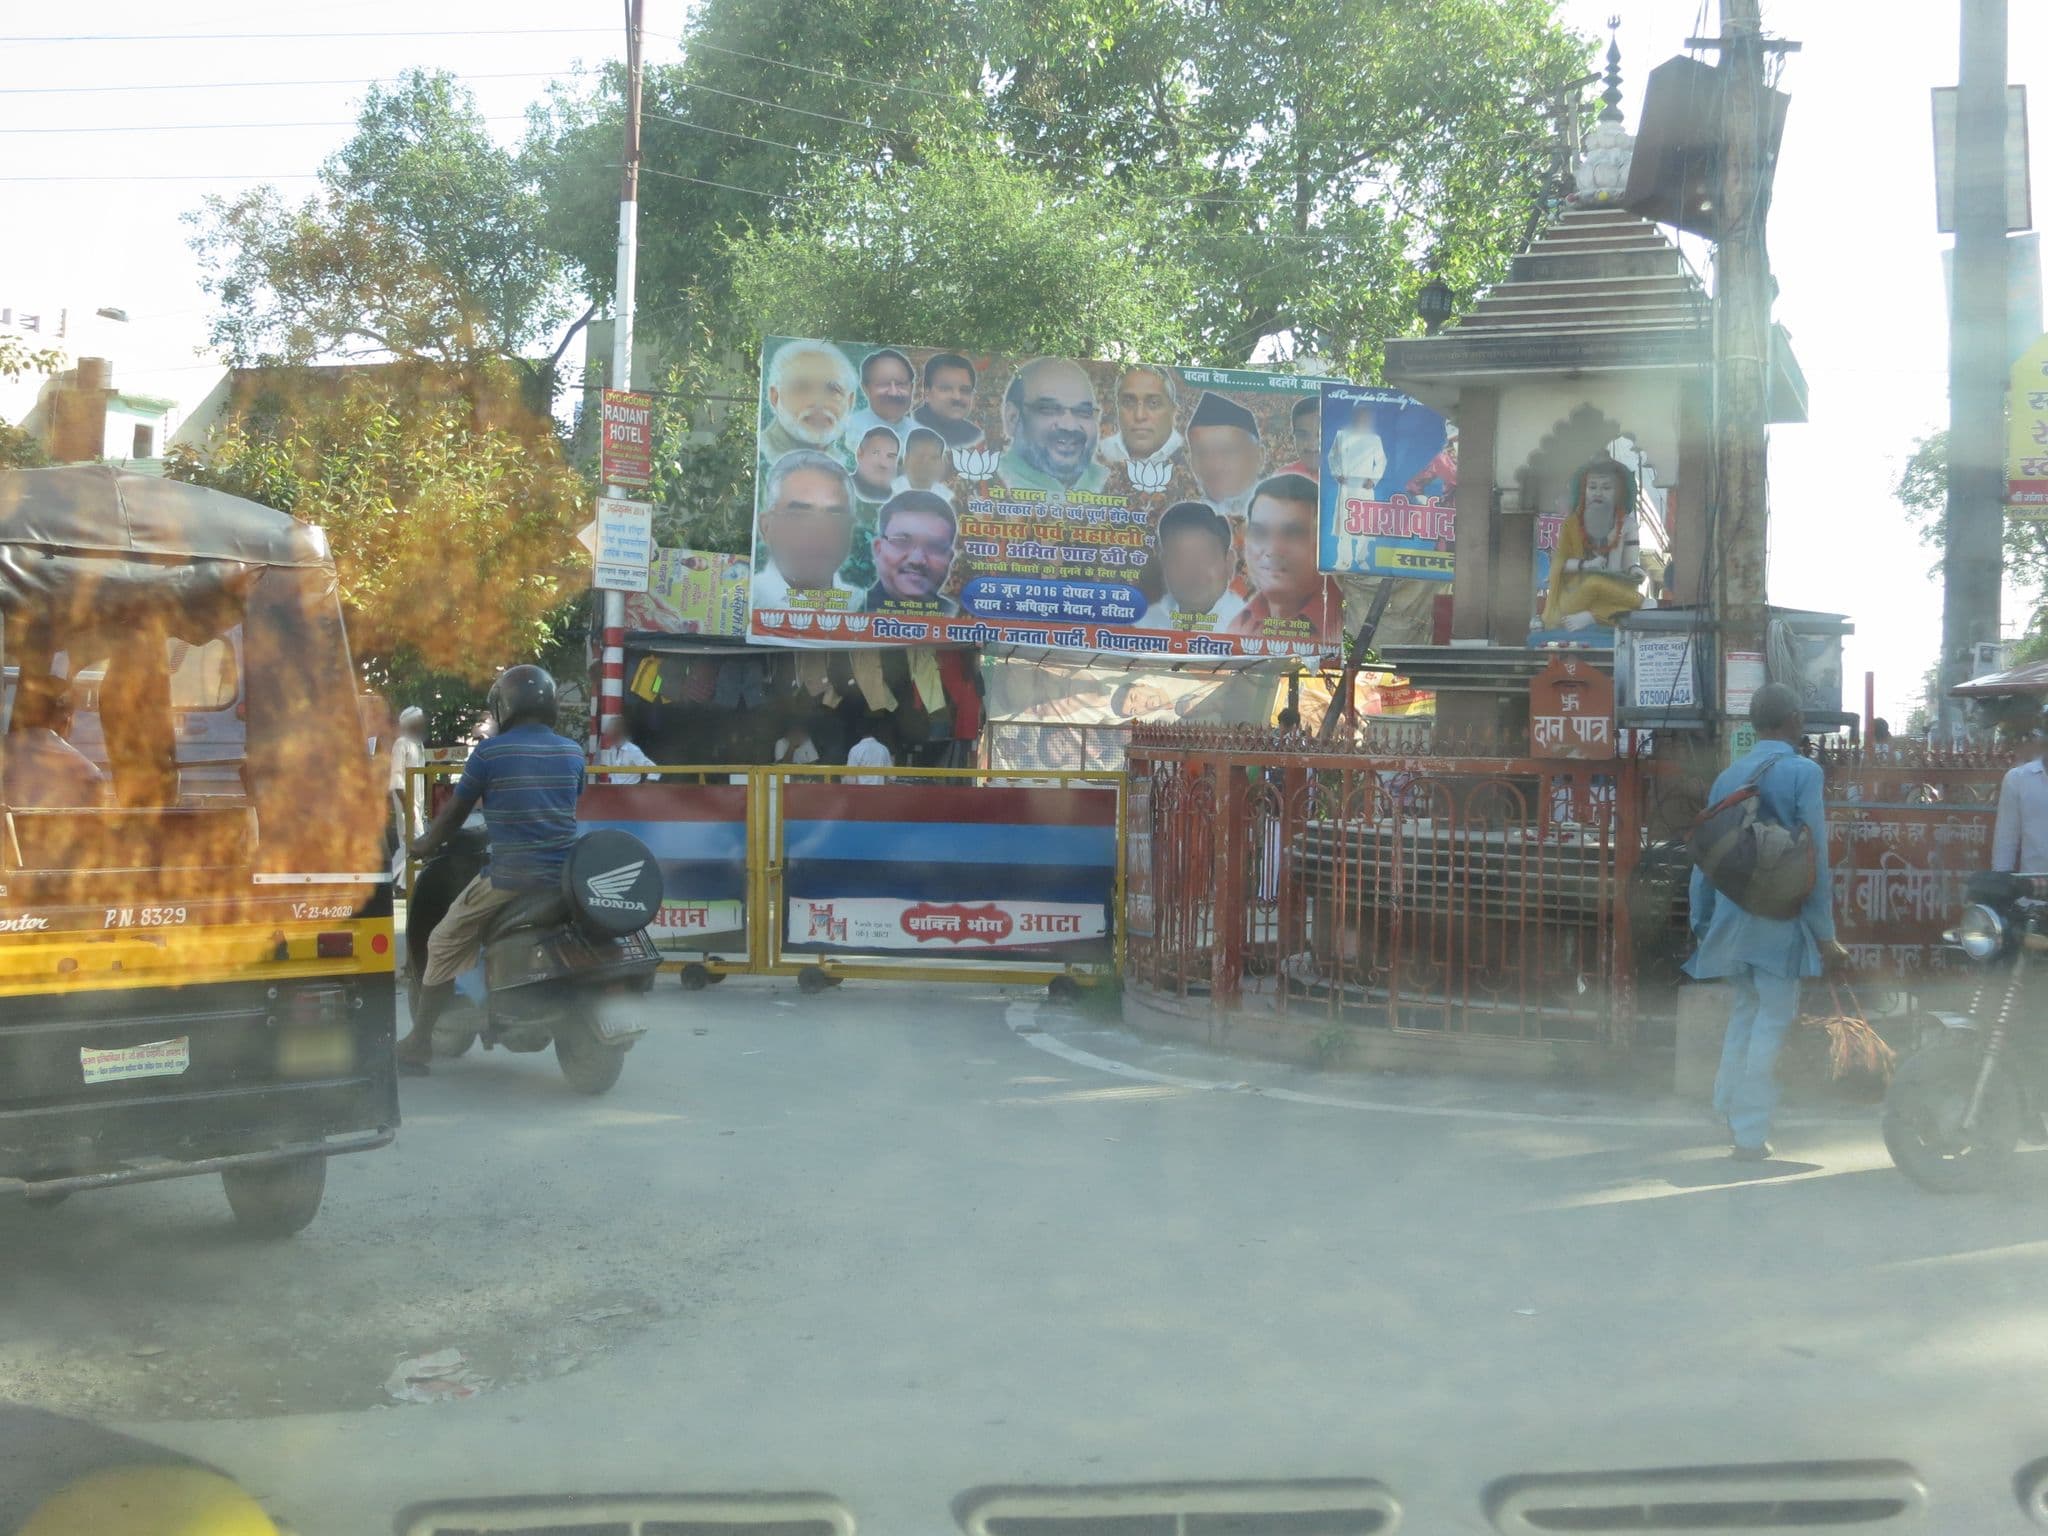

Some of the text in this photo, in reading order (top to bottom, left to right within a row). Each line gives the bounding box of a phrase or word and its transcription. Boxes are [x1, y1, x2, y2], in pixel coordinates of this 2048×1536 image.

[623, 394, 649, 408] ROOMS
[605, 404, 649, 426] RADIANT
[609, 423, 644, 444] HOTEL
[988, 485, 1006, 499] दो
[1010, 487, 1047, 502] साल
[968, 499, 1147, 525] मोदी सरकार के दो वर्ष पूर्ण होने पर
[1344, 493, 1457, 541] आशीर्वाद
[960, 514, 1029, 539] विकास
[1032, 520, 1064, 541] पर्व
[1006, 541, 1059, 560] अमित
[1061, 546, 1098, 563] शाह
[1100, 546, 1128, 565] जी
[1129, 550, 1149, 566] के
[980, 582, 997, 594] 25
[1001, 583, 1021, 597] जून
[1026, 585, 1058, 597] 2016
[1062, 584, 1095, 599] दोपहर
[1099, 589, 1107, 600] 3
[974, 599, 1001, 611] स्थान
[1016, 599, 1058, 617] ऋषिकुल
[1101, 603, 1136, 619] हरिद्वार
[872, 617, 928, 639] निवेदक
[946, 621, 1001, 643] भारतीय
[1005, 629, 1050, 645] जनता
[1096, 627, 1170, 652] विधानसभा
[1187, 635, 1233, 656] हरिद्वार
[1640, 689, 1691, 704] 875000424
[1534, 716, 1610, 748] दान पात्र
[588, 897, 648, 912] HONDA
[140, 907, 187, 926] 8329
[966, 916, 1003, 933] भोग
[1020, 913, 1083, 933] आटा
